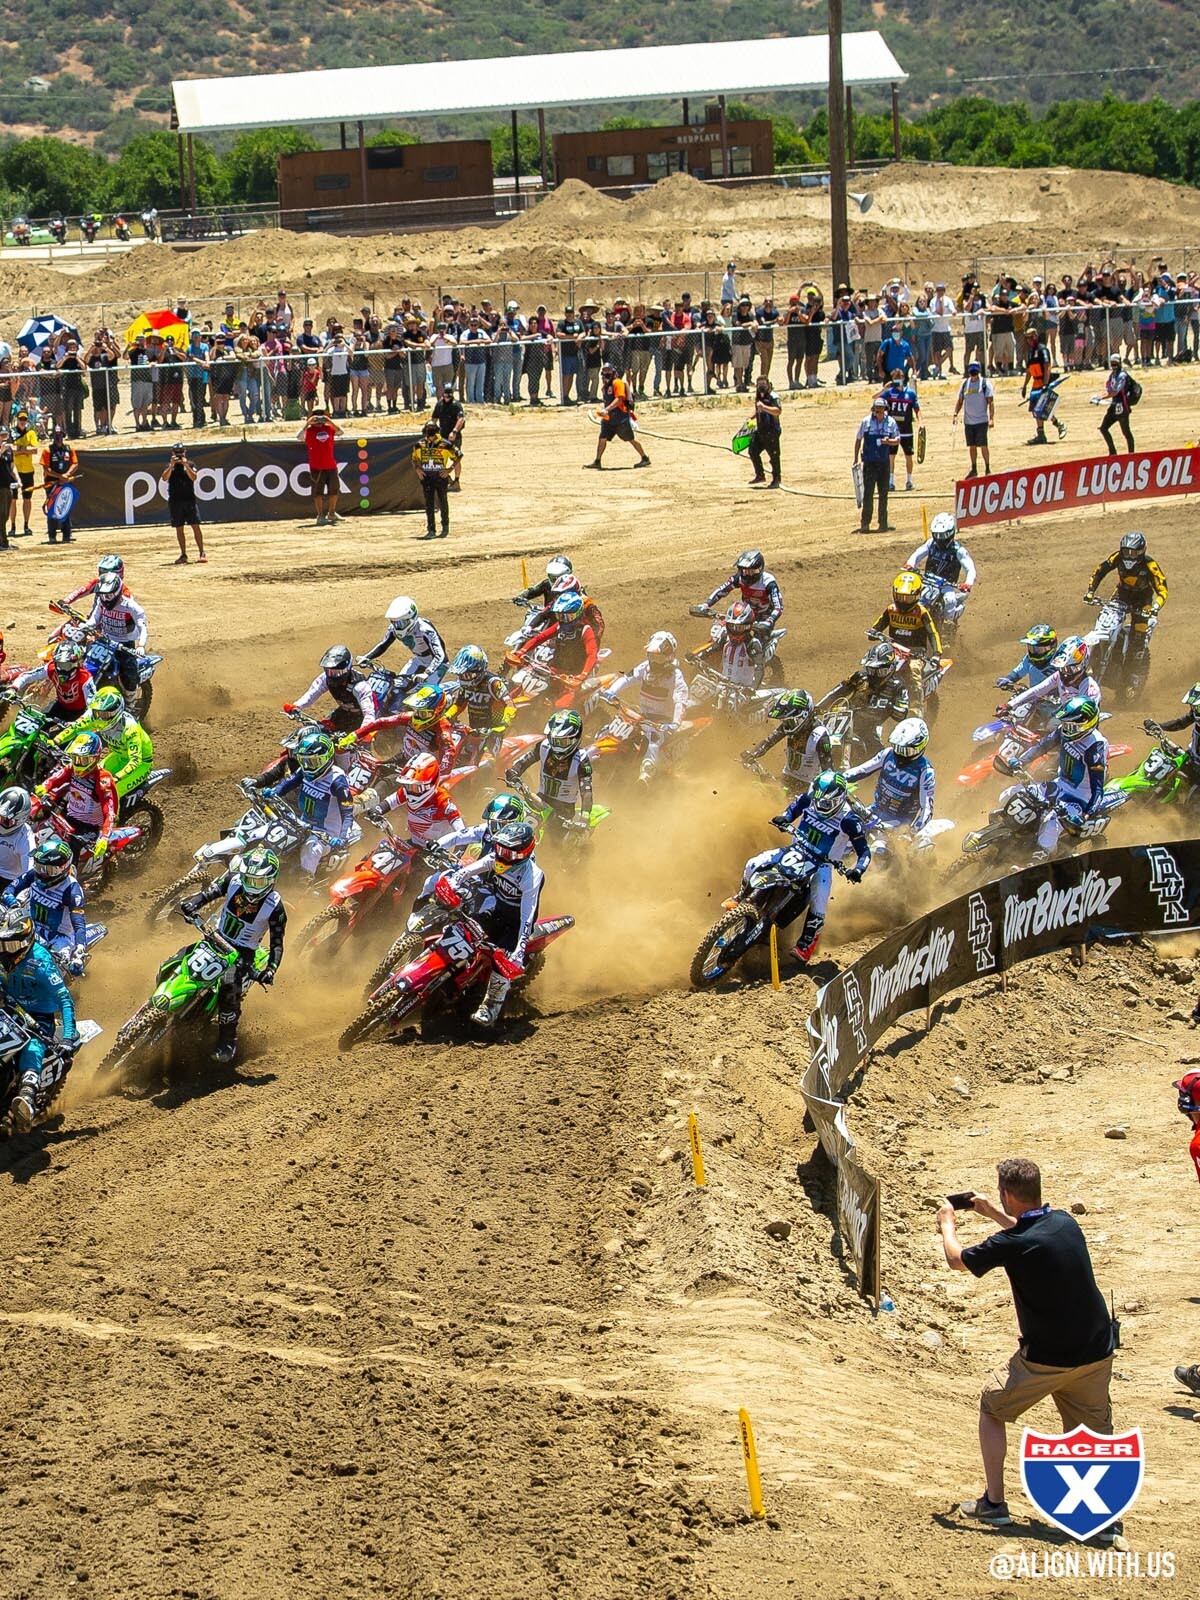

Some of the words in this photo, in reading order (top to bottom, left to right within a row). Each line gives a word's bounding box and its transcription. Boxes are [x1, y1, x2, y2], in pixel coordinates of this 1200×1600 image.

[891, 402, 909, 413] FLY
[956, 479, 1026, 519] LUCAS
[1032, 471, 1065, 504] OIL
[1077, 457, 1150, 496] LUCAS
[1156, 455, 1193, 488] OIL
[15, 716, 40, 738] 726
[826, 714, 853, 737] 47
[1063, 742, 1082, 760] THOR
[349, 766, 372, 789] 45
[883, 760, 919, 787] FXR
[302, 784, 326, 800] THOR
[1006, 799, 1038, 825] 59
[804, 814, 834, 835] THOR
[1080, 819, 1104, 839] 59
[779, 852, 817, 876] 64
[30, 891, 58, 909] THOR
[439, 928, 475, 961] 75
[744, 921, 765, 945] DUNLOP
[186, 951, 223, 981] 150
